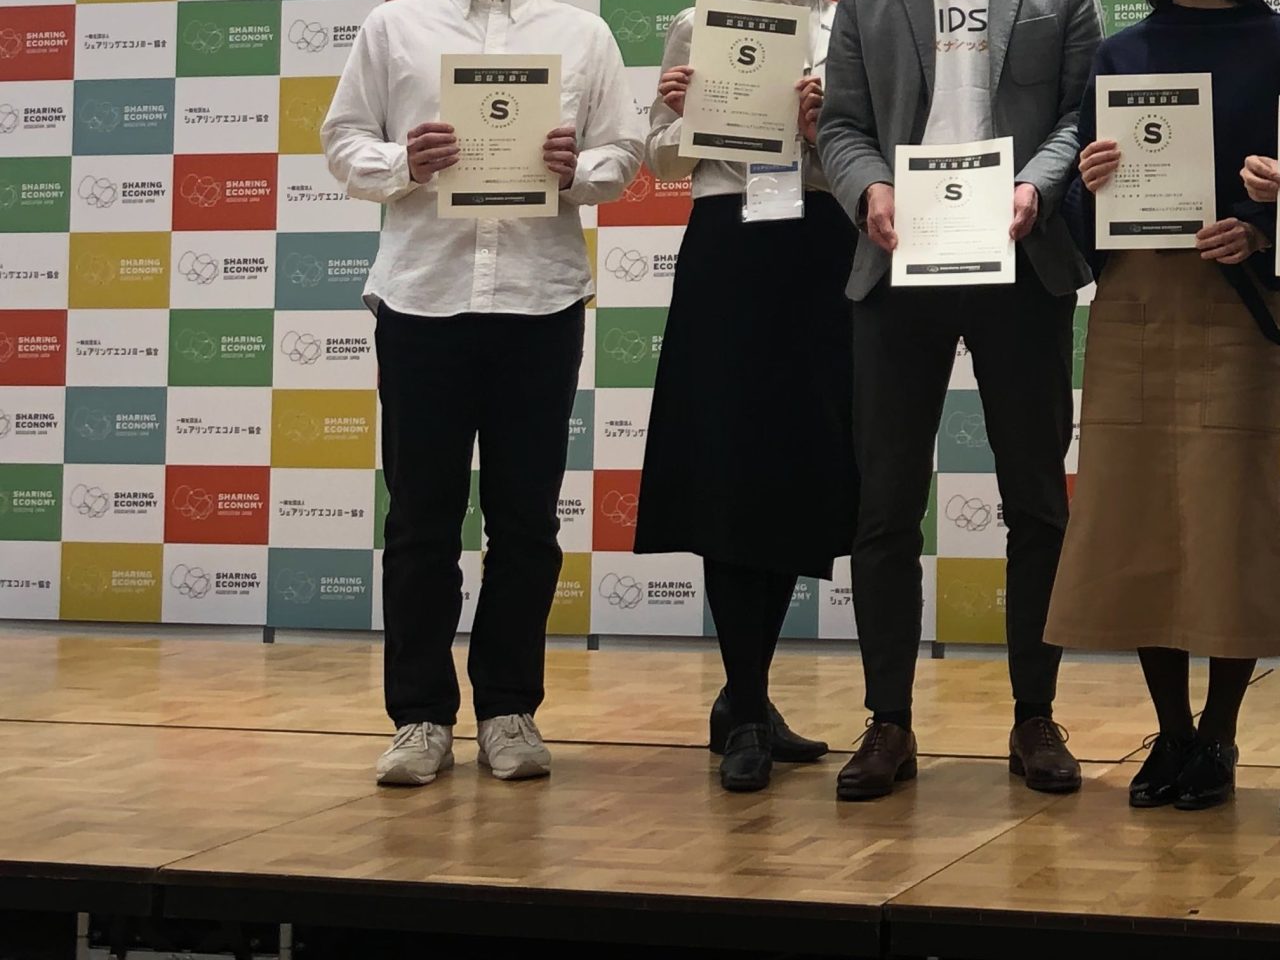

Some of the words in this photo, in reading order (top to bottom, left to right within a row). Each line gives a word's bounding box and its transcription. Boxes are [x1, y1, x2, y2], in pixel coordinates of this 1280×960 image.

[737, 45, 757, 66] S
[489, 99, 510, 120] S
[1143, 122, 1162, 144] S
[944, 183, 963, 201] S
[320, 576, 362, 584] SHARING
[648, 581, 691, 589] SHARING
[320, 585, 365, 593] ECONOMY
[648, 590, 695, 598] ECONOMY
